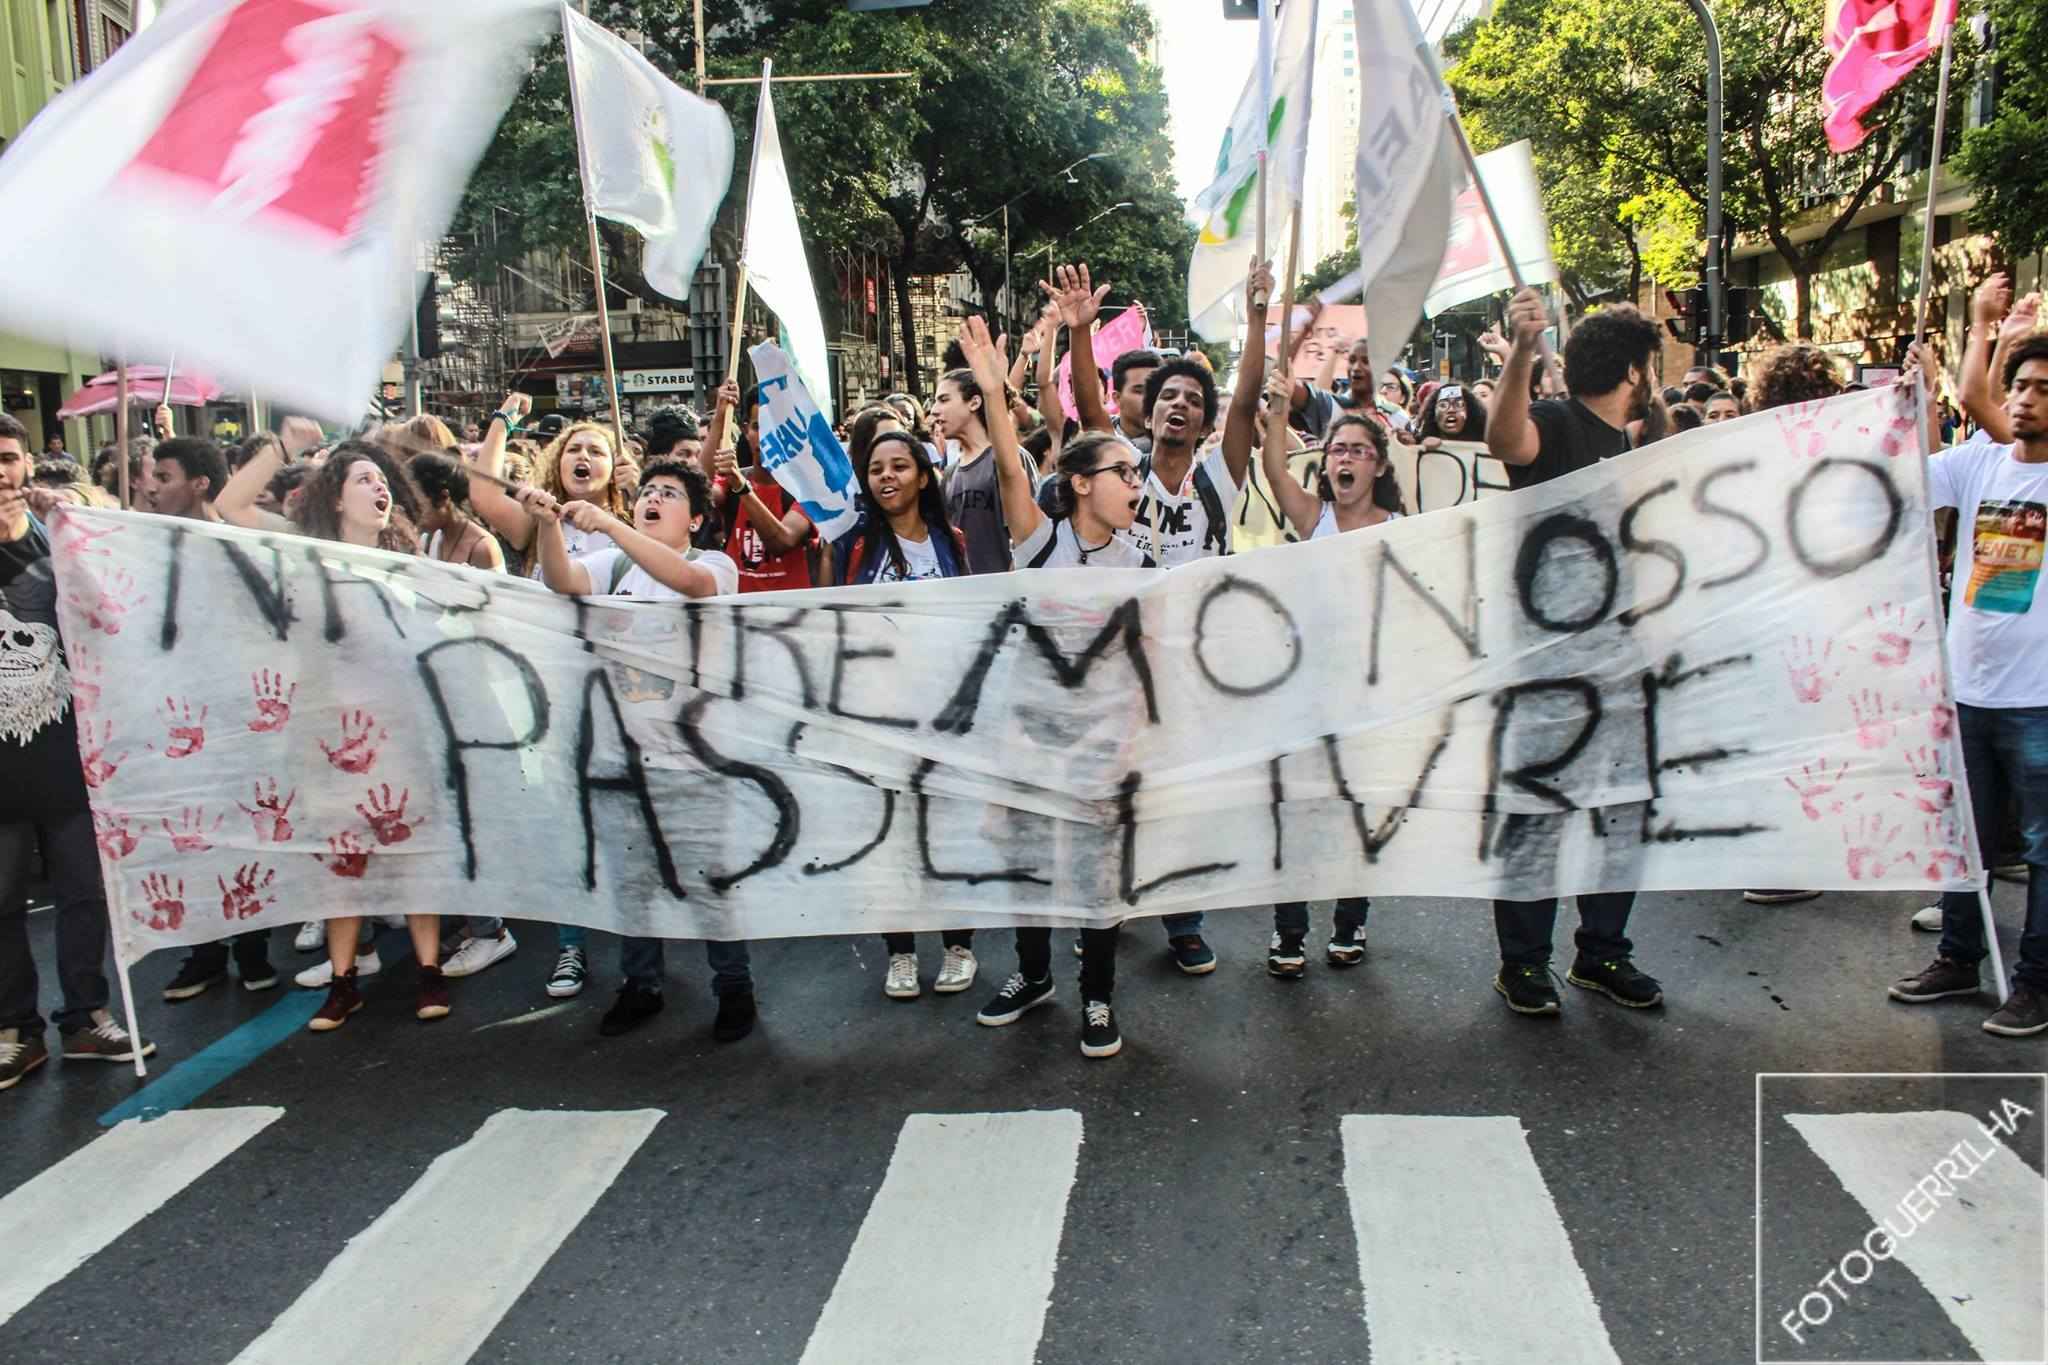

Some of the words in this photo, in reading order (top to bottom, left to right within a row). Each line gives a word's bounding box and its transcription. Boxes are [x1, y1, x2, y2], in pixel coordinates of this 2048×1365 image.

[648, 375, 695, 385] STARBU
[1366, 457, 1905, 685] NOSSO
[1117, 650, 1778, 906] LIVRE
